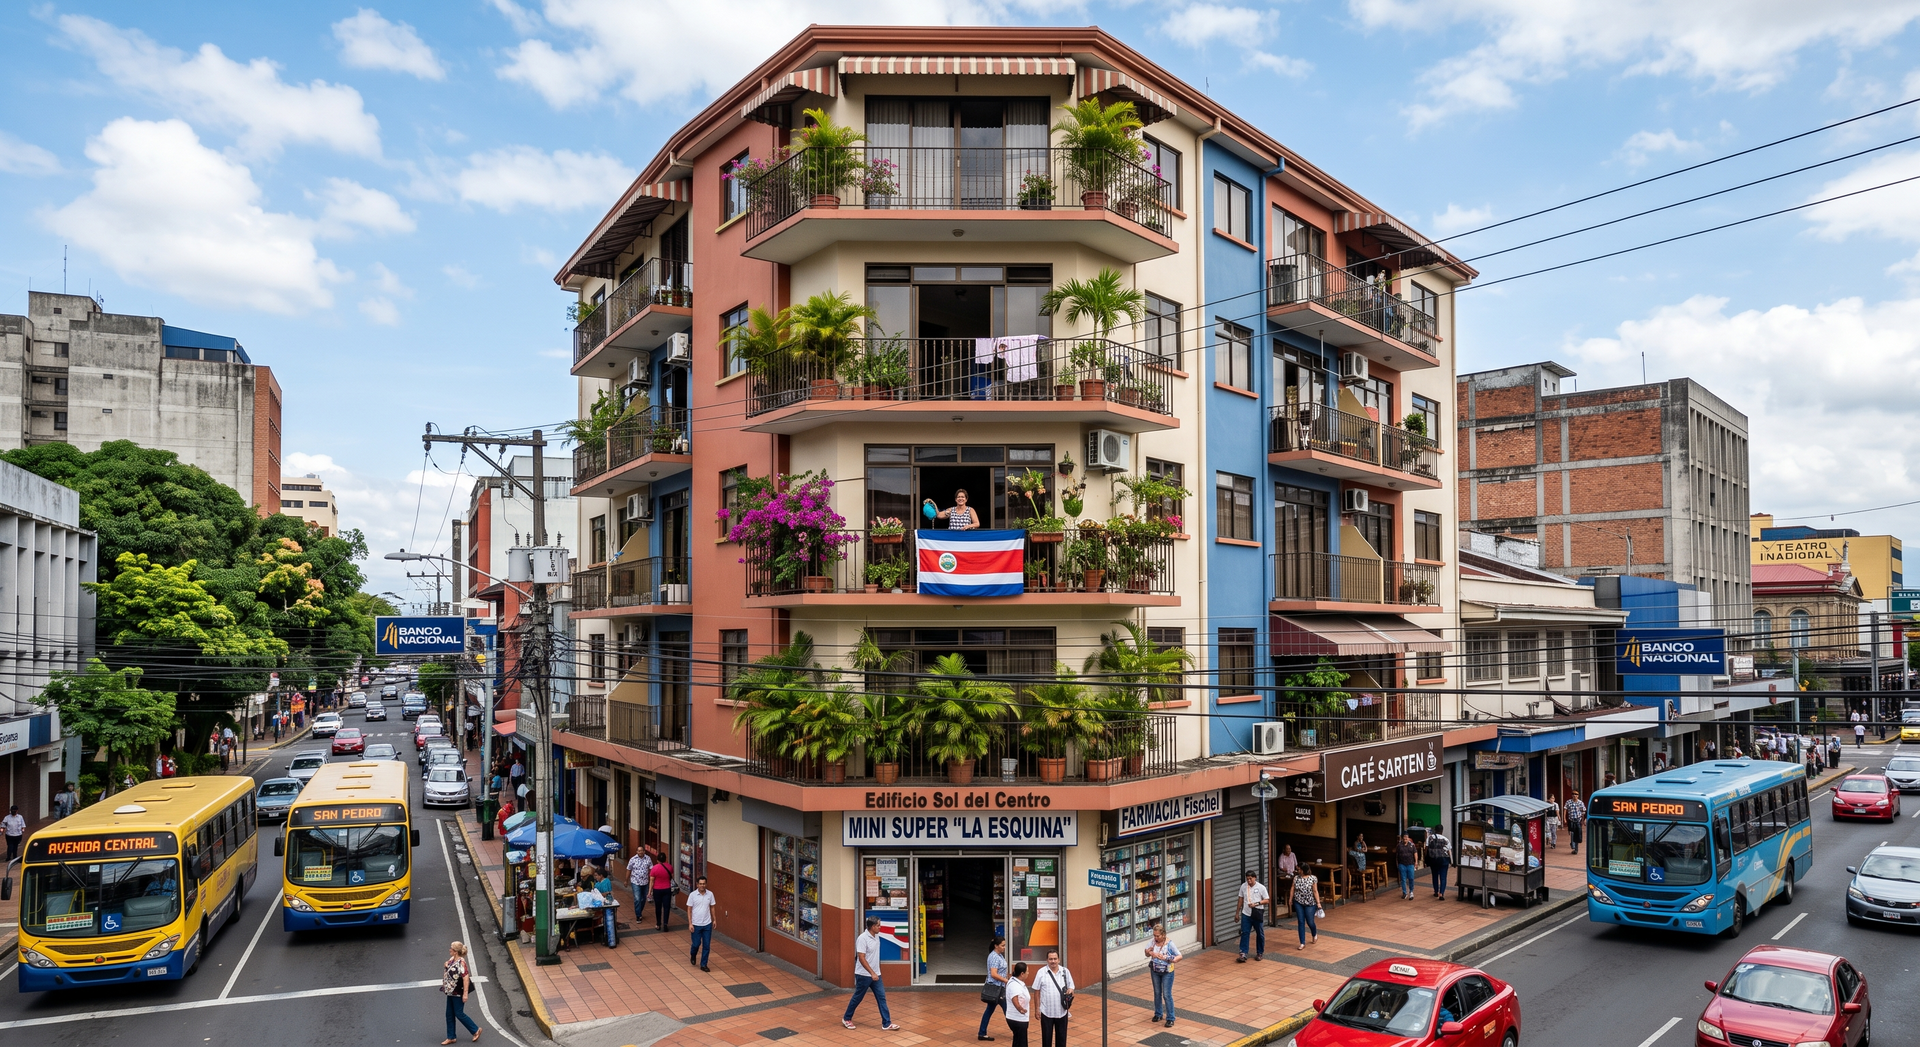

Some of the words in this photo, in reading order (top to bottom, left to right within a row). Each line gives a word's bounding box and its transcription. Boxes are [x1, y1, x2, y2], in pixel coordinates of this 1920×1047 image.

[1776, 541, 1827, 552] TEATRO
[398, 627, 442, 635] BANCO
[399, 635, 461, 645] NACIONAL
[1641, 642, 1694, 652] BANCO
[1642, 653, 1719, 663] NACIONAL
[1341, 755, 1375, 789] CAFÉ
[1378, 752, 1424, 780] SARTEN
[865, 792, 928, 808] Edificio
[933, 792, 959, 808] Sol
[964, 792, 989, 808] del
[995, 792, 1051, 808] Centro
[313, 809, 338, 820] SAN
[342, 807, 382, 819] PEDRO
[1122, 799, 1181, 829] FARMACIA
[1184, 791, 1219, 817] Fischel
[1612, 801, 1637, 813] SAN
[1641, 802, 1684, 815] PEDRO
[848, 817, 886, 838] MINI
[892, 817, 949, 838] SUPER
[48, 840, 101, 855] AVENIDA
[104, 837, 158, 851] CENTRAL
